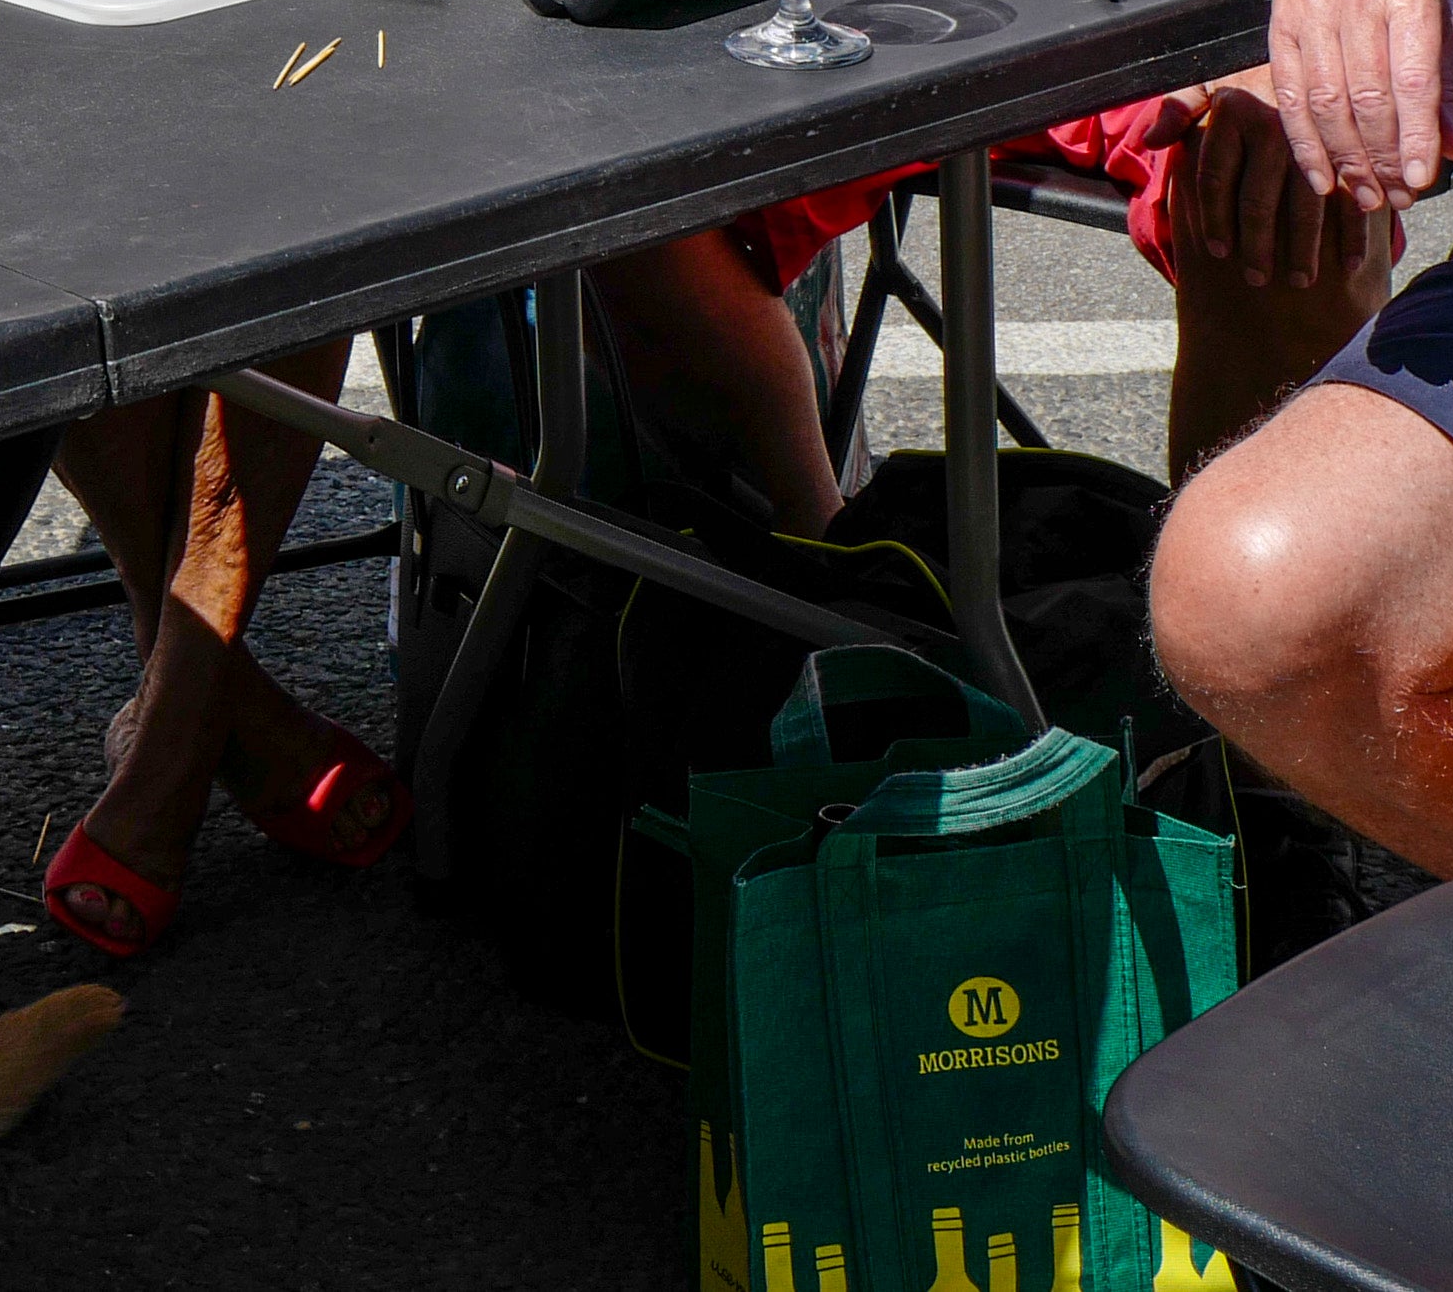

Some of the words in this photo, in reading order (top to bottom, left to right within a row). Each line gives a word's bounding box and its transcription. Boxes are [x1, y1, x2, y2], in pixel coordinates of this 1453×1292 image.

[962, 987, 1008, 1026] M
[918, 1039, 1060, 1074] MORRISONS
[927, 1154, 981, 1174] recycled
[984, 1150, 1026, 1169] plastic
[1028, 1140, 1070, 1159] bottles
[964, 1135, 1000, 1150] Made
[1003, 1132, 1034, 1146] from
